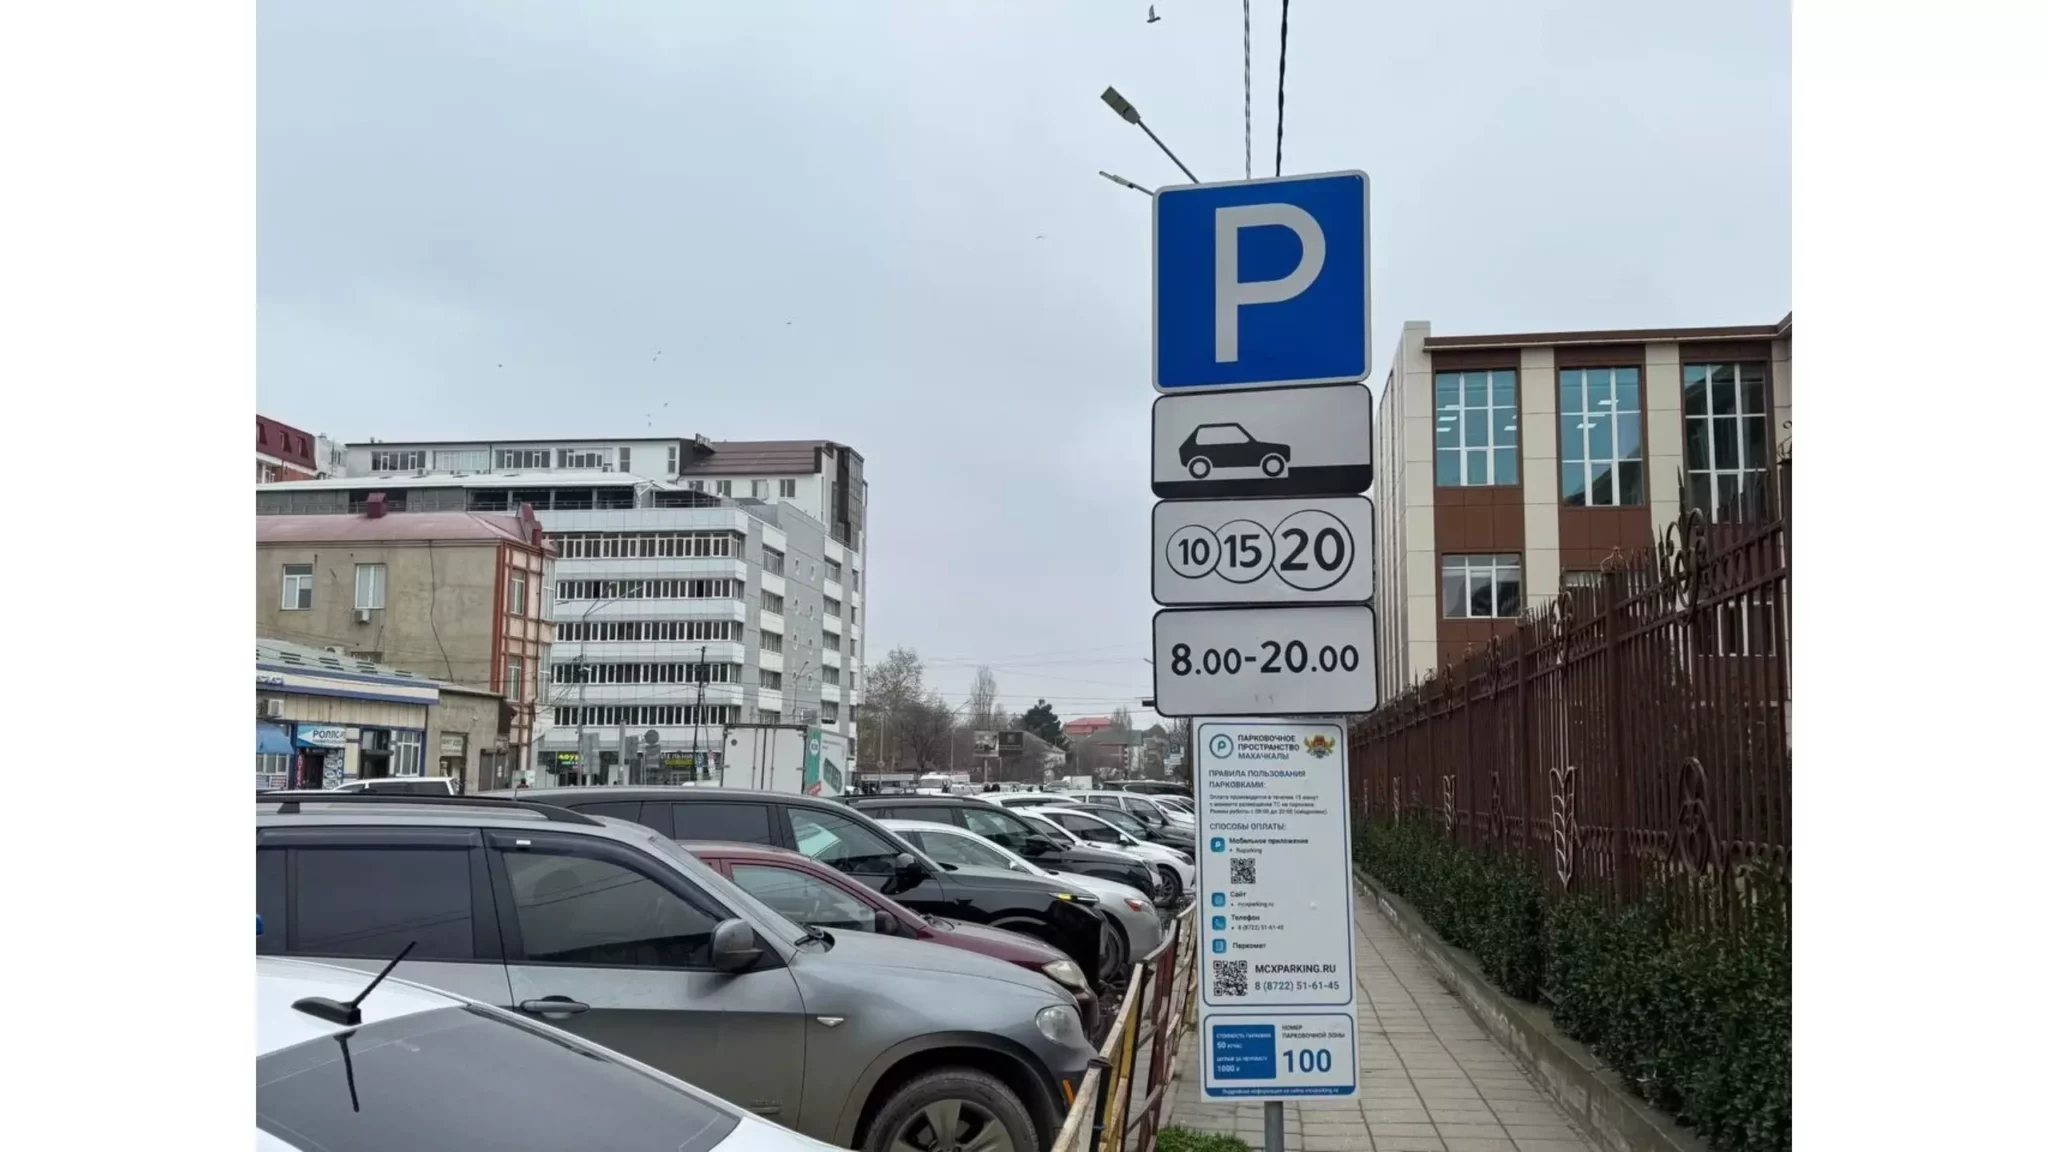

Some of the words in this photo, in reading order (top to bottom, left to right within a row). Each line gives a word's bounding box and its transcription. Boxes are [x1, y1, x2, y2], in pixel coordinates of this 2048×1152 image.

[1214, 202, 1327, 363] P
[1178, 538, 1210, 566] 10
[1224, 534, 1263, 568] 15
[1280, 527, 1345, 572] 20
[1171, 639, 1359, 676] 8.00-20.00
[1238, 734, 1296, 742] ПАРКОВОЧНОЕ
[1238, 744, 1300, 752] ПРОСТРАНСТВО
[1238, 752, 1289, 760] МАХАЧКАЛЫ
[1209, 770, 1246, 778] ПРАВИЛА
[1248, 770, 1306, 778] ПОЛЬЗОВАНИЯ
[1209, 780, 1266, 788] ПАРКОВКАМИ:
[1231, 914, 1260, 922] Телефон
[1233, 942, 1266, 950] Паркомат
[1255, 964, 1336, 974] MCXPARKING.RU
[1255, 982, 1260, 990] 8
[1263, 982, 1294, 992] (8722)
[1297, 981, 1339, 990] 51-61-45
[1283, 1049, 1331, 1073] 100
